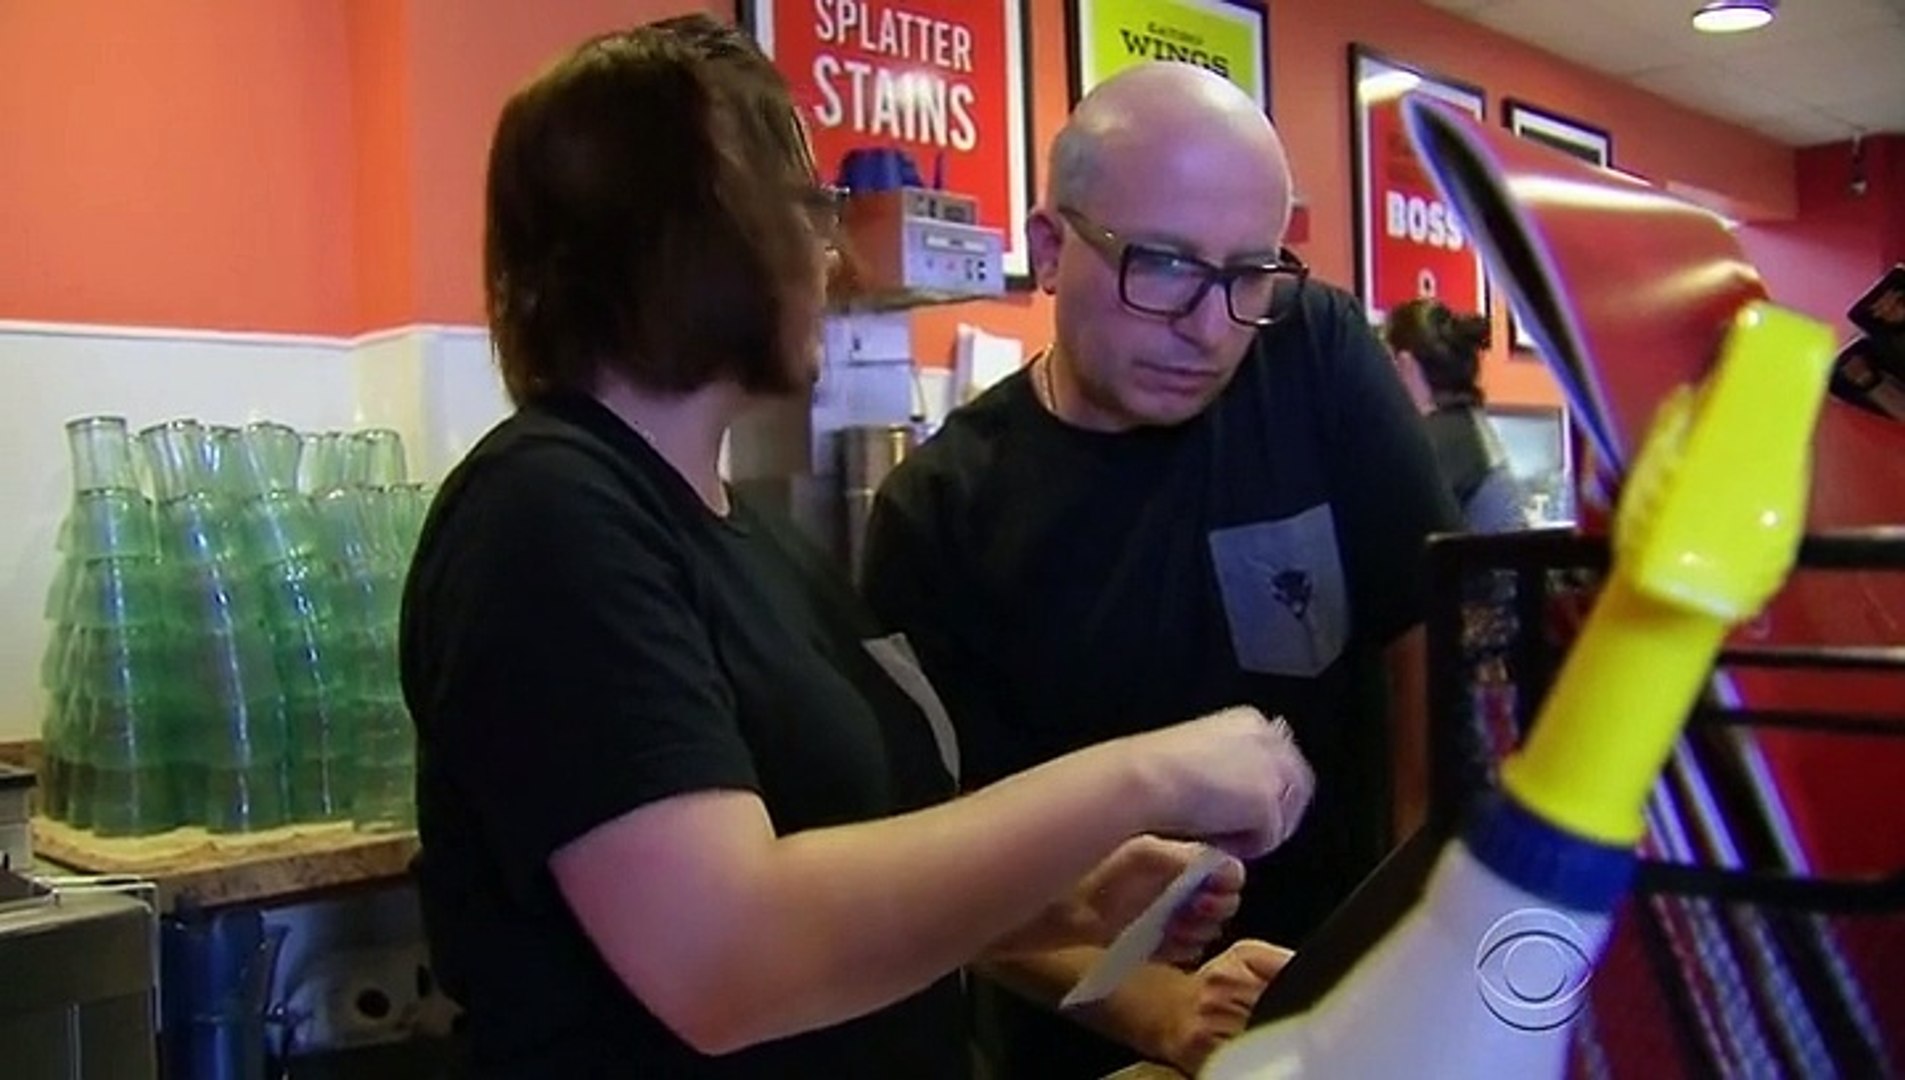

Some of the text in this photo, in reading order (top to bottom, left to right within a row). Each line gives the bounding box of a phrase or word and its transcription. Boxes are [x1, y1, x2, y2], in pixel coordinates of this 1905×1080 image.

[815, 0, 972, 72] SPLATTER
[1120, 28, 1229, 78] WINGS
[813, 54, 976, 150] STAINS
[1386, 190, 1465, 251] BOSS
